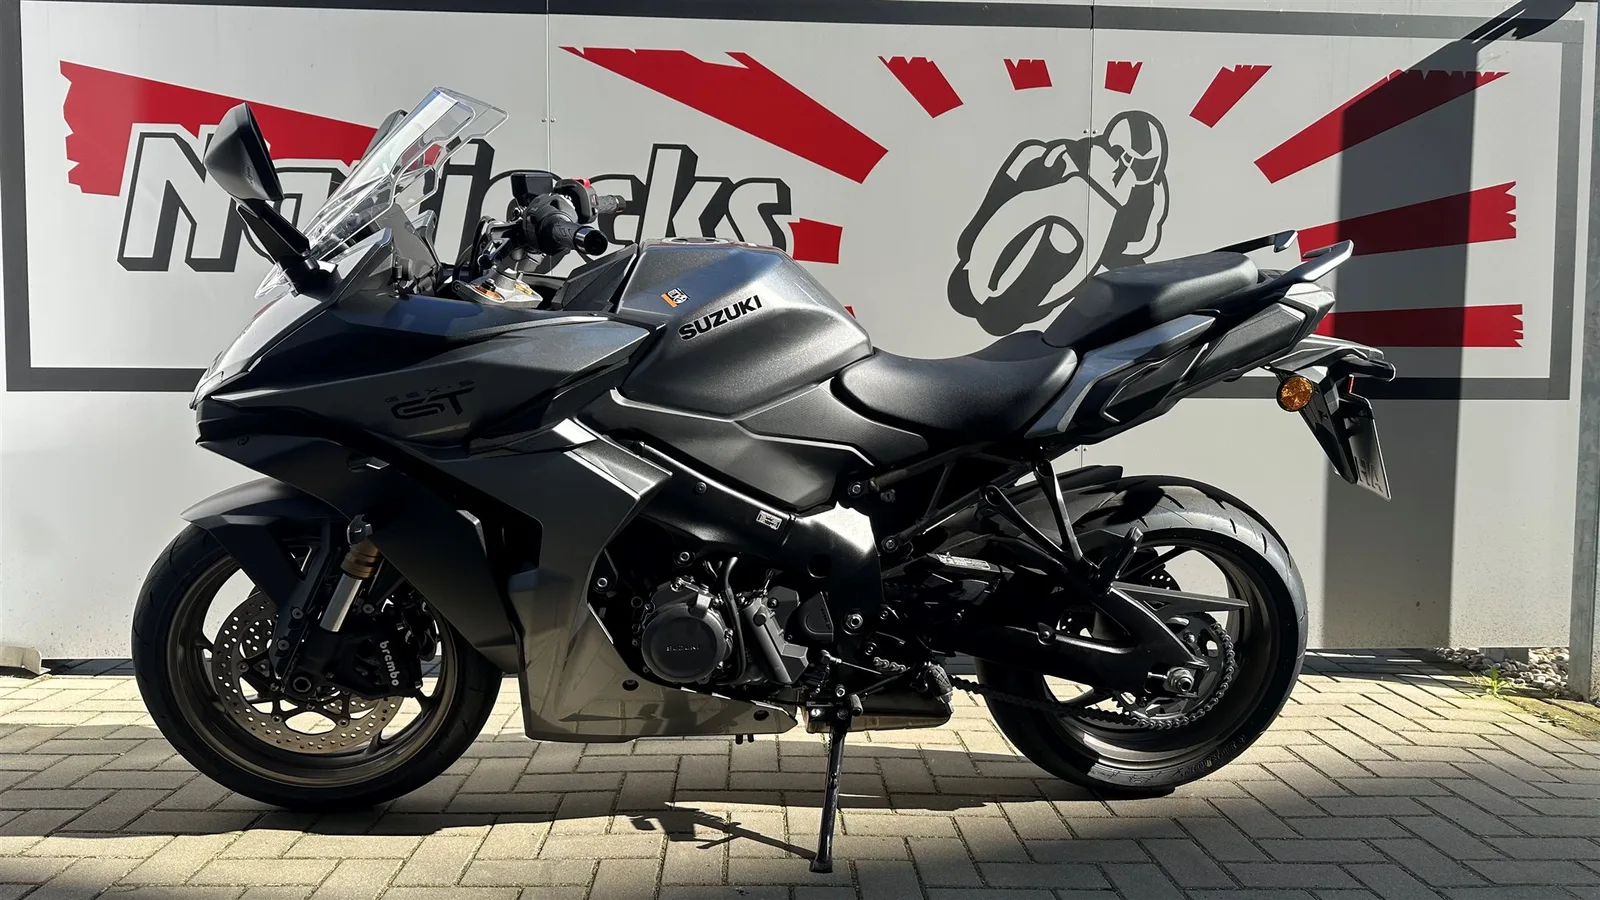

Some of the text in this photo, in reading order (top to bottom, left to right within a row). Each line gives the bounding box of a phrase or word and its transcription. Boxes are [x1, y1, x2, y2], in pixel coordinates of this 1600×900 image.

[678, 294, 762, 340] SUZUKI
[390, 386, 476, 420] GT
[379, 640, 401, 687] brembo
